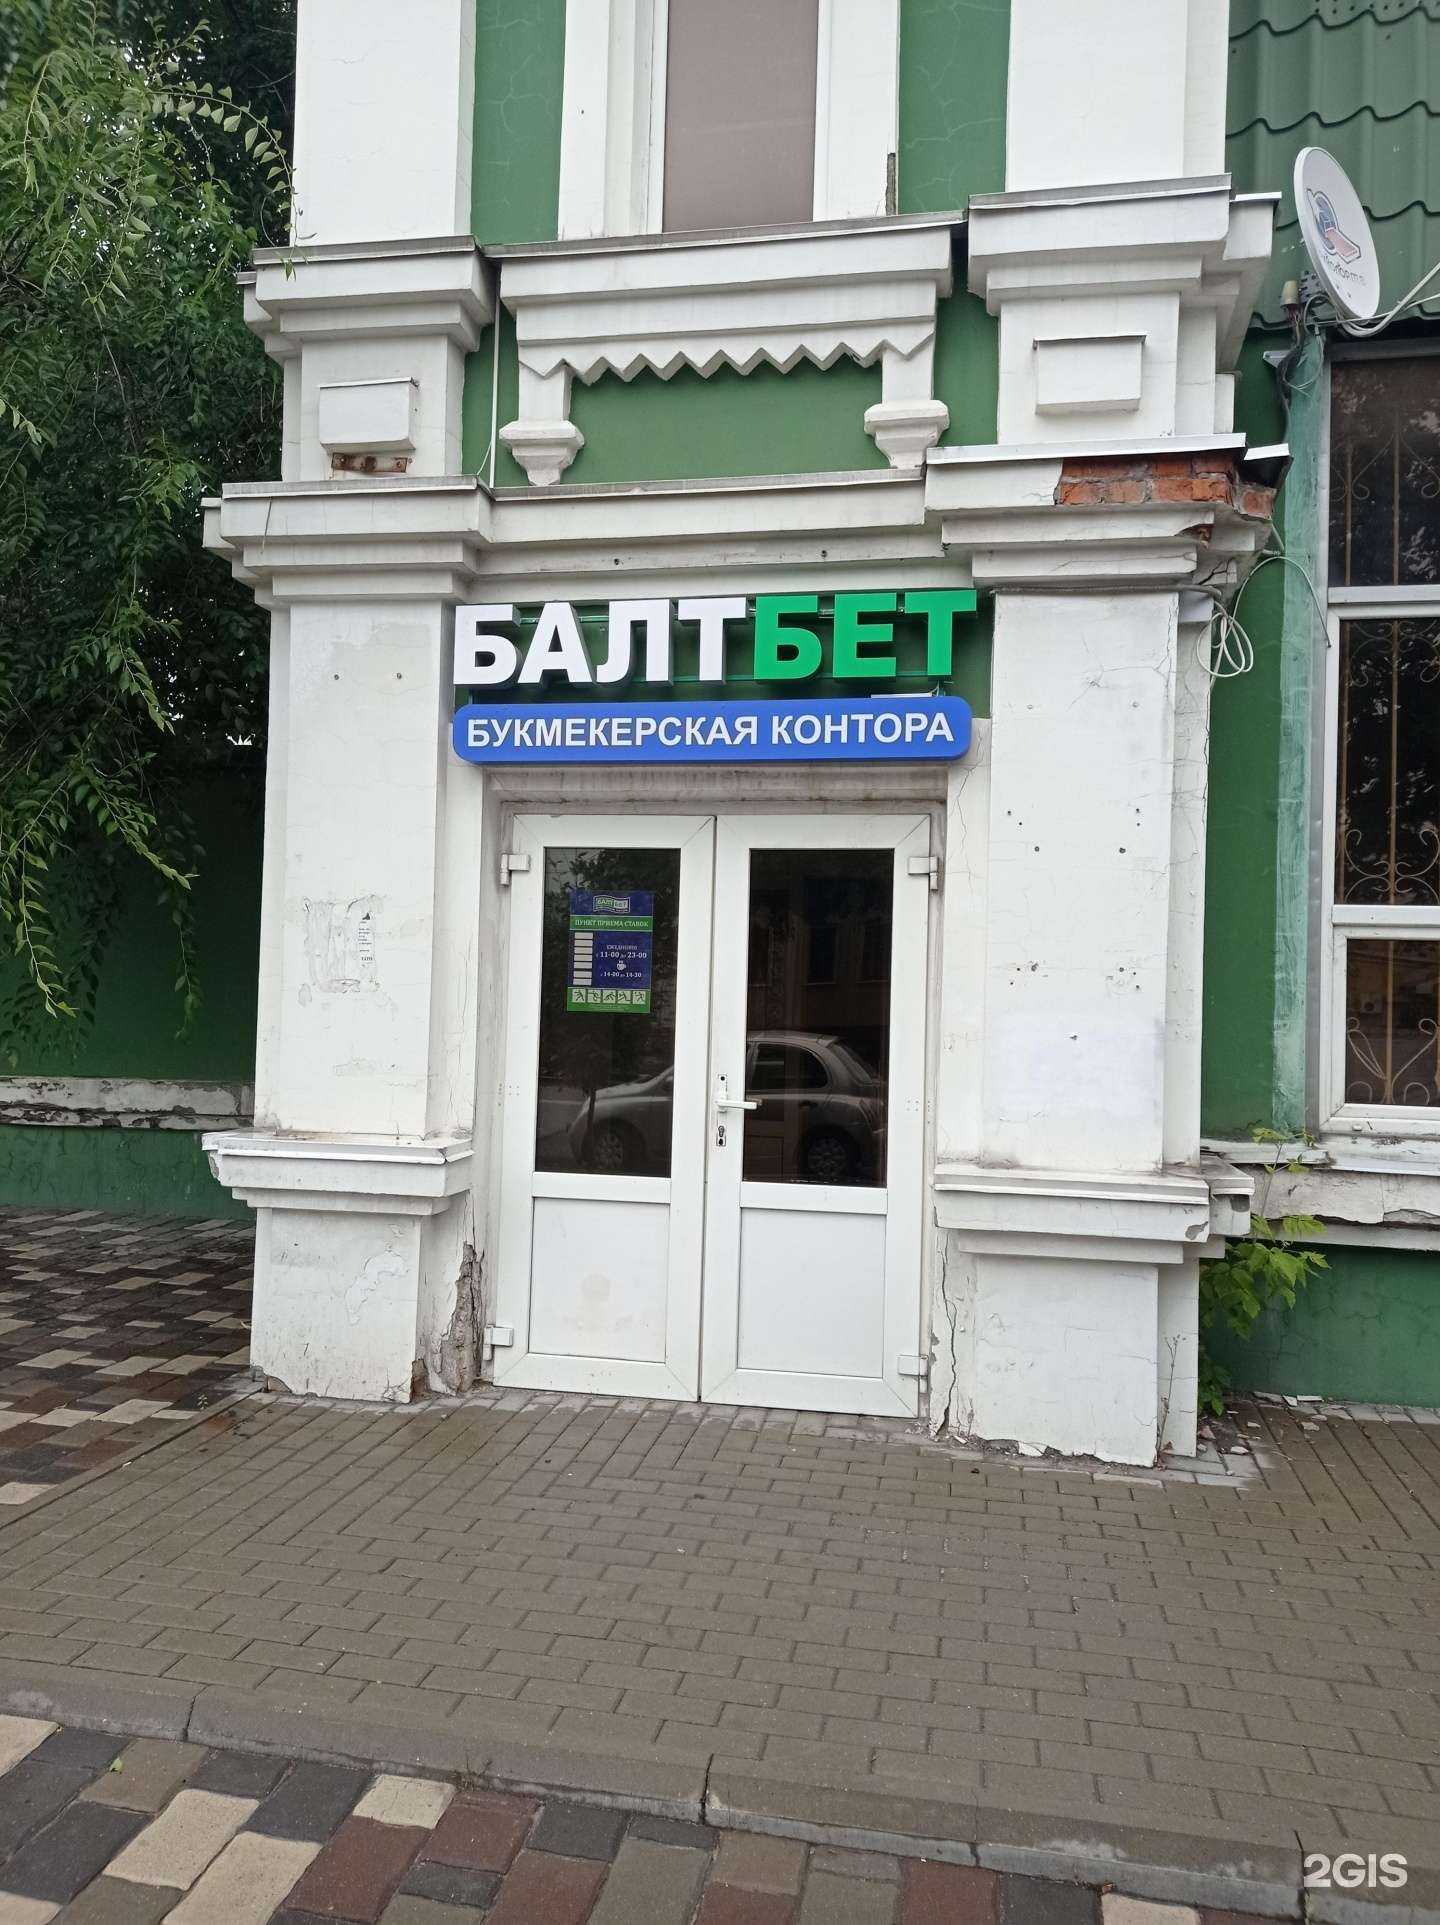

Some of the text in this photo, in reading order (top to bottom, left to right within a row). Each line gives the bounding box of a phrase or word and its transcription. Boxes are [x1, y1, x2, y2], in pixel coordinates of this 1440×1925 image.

[453, 590, 977, 686] БАЛТБЕТ
[466, 712, 955, 748] БУКМЕКЕРСКАЯ КОНТОРА
